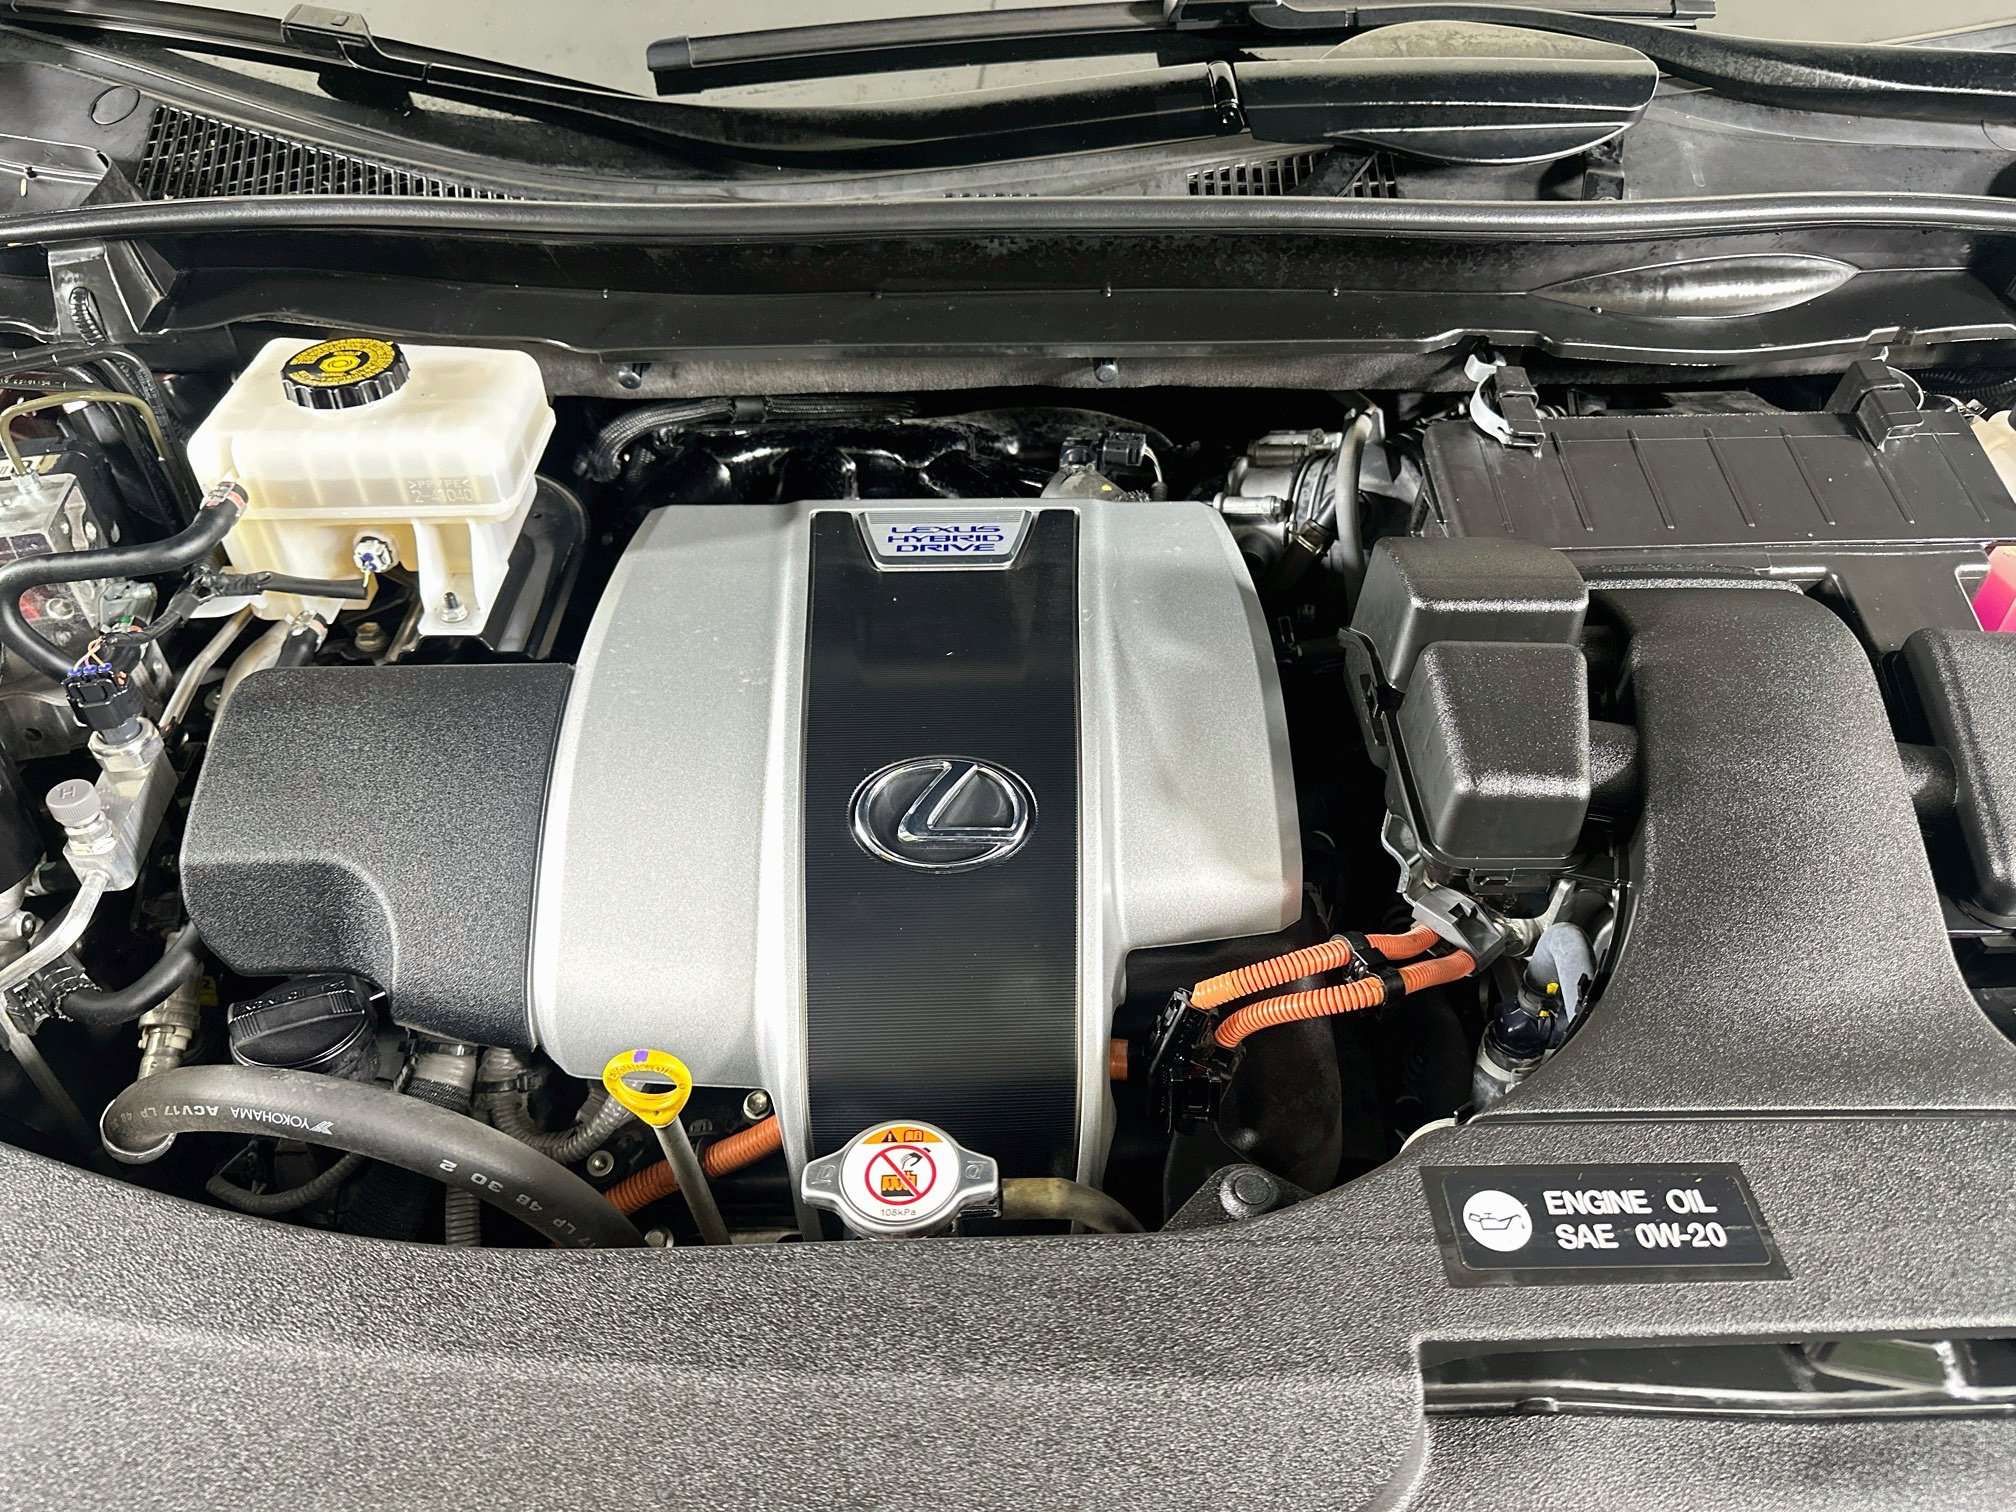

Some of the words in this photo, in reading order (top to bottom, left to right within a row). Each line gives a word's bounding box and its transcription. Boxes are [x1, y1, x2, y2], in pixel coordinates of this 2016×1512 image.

[891, 525, 1001, 533] LEXUS
[887, 534, 1004, 543] HYBRID
[896, 543, 996, 552] DRIVE
[164, 1105, 219, 1116] ACV17
[230, 1106, 310, 1129] YOKOHAMA
[439, 1159, 458, 1173] 2
[471, 1172, 504, 1193] 30
[516, 1194, 543, 1212] 4B
[1543, 1189, 1652, 1215] ENGINE
[1665, 1188, 1718, 1214] OIL
[881, 1208, 917, 1217] 108kPa
[552, 1218, 577, 1235] LP
[1555, 1223, 1619, 1250] SAE
[1634, 1222, 1727, 1249] 0W-20
